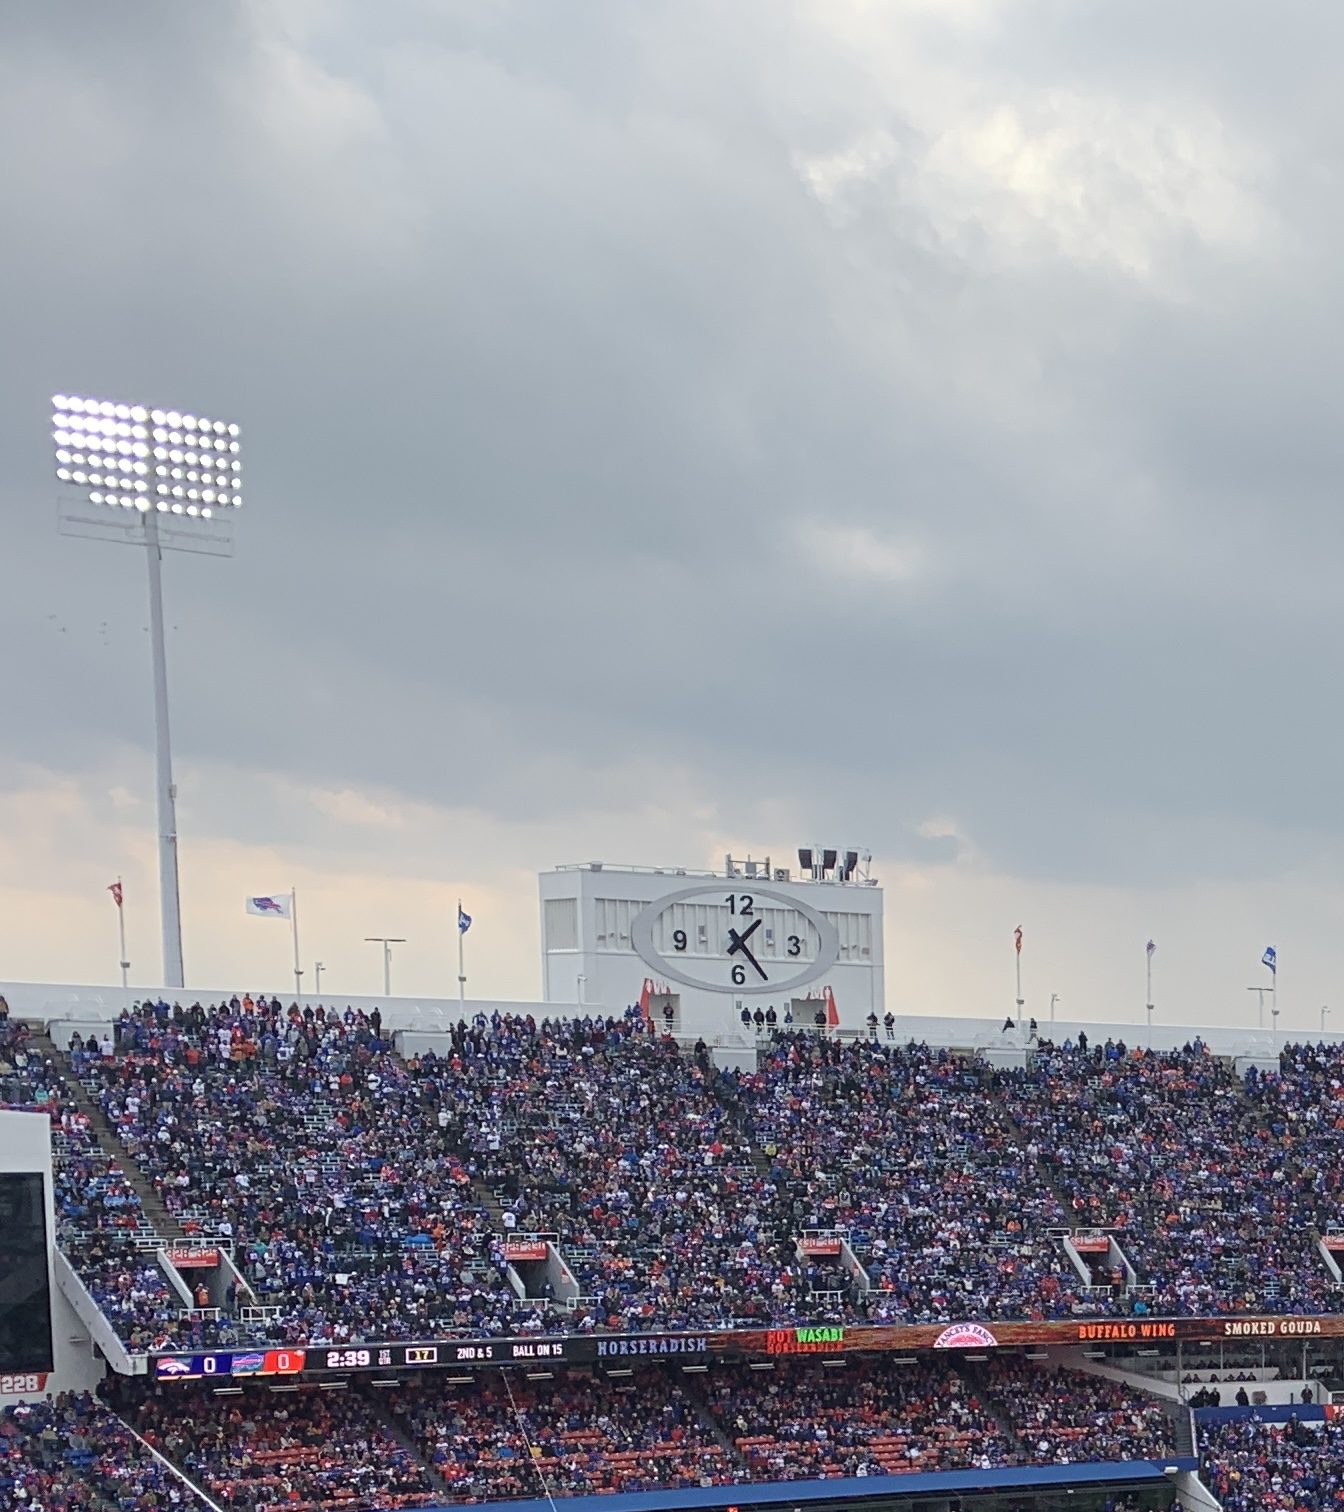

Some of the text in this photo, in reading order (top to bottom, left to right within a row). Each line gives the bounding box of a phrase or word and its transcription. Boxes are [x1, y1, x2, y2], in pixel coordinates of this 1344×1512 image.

[725, 895, 753, 915] 12
[673, 930, 686, 951] 9
[788, 936, 801, 956] 3
[731, 965, 745, 985] 6
[796, 1328, 844, 1343] WASABI
[1078, 1322, 1176, 1340] BUFFALO WING
[1224, 1320, 1321, 1336] SMOKED GOUDA
[415, 1344, 562, 1360] 17 2ND & 5 BALL ON 15
[597, 1338, 707, 1356] HORSERADISH
[203, 1350, 370, 1373] 0 0 2:39
[1, 1374, 38, 1394] 228
